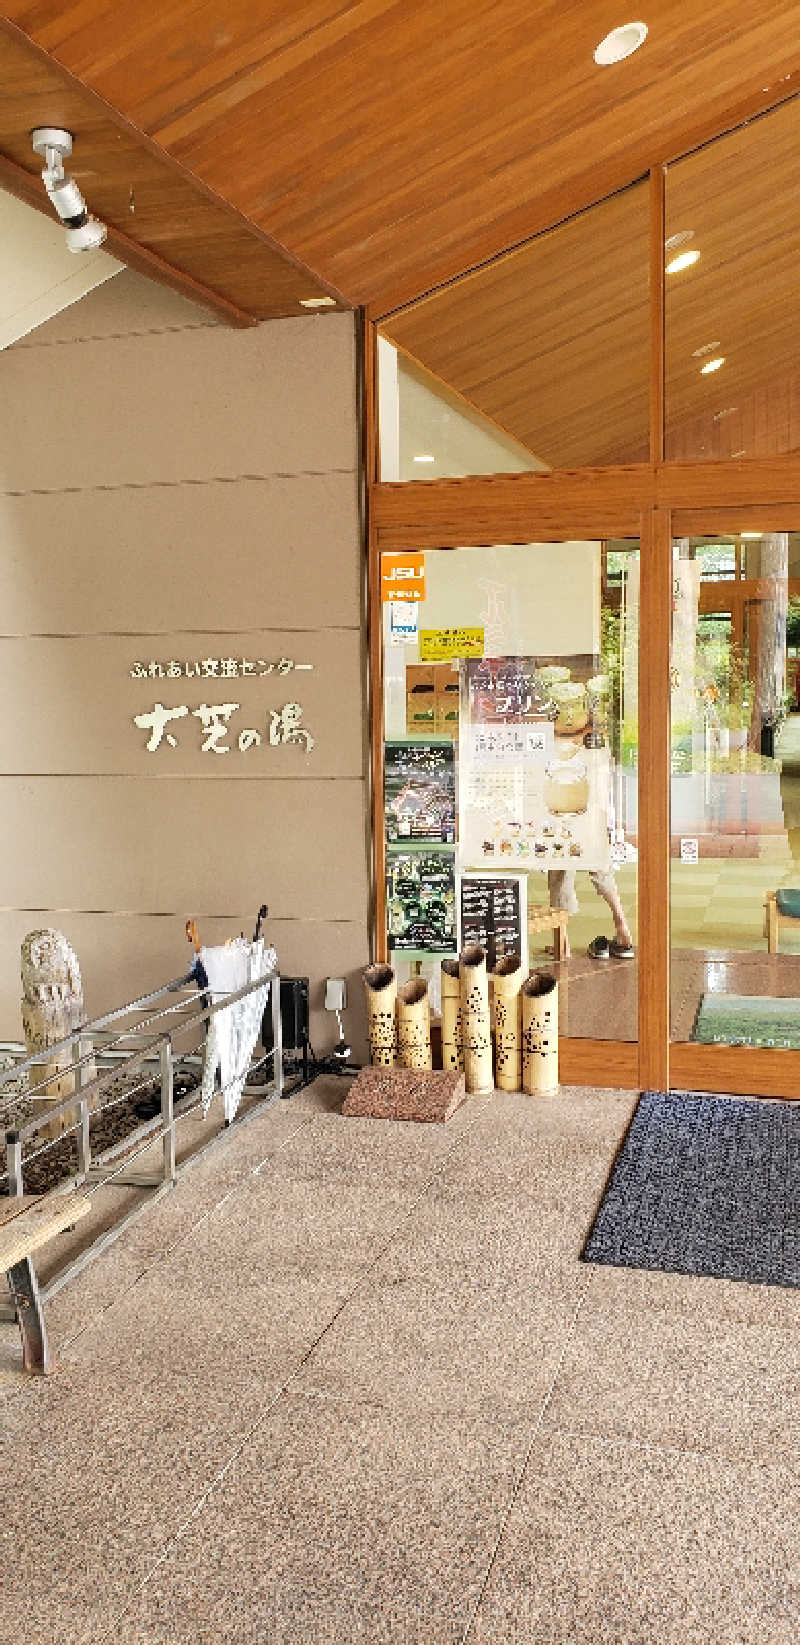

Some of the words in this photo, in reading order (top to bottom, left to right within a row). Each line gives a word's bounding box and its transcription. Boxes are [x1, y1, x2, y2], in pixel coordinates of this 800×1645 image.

[130, 658, 313, 679] ふれあい交流センター
[132, 702, 315, 755] 大芝の湯
